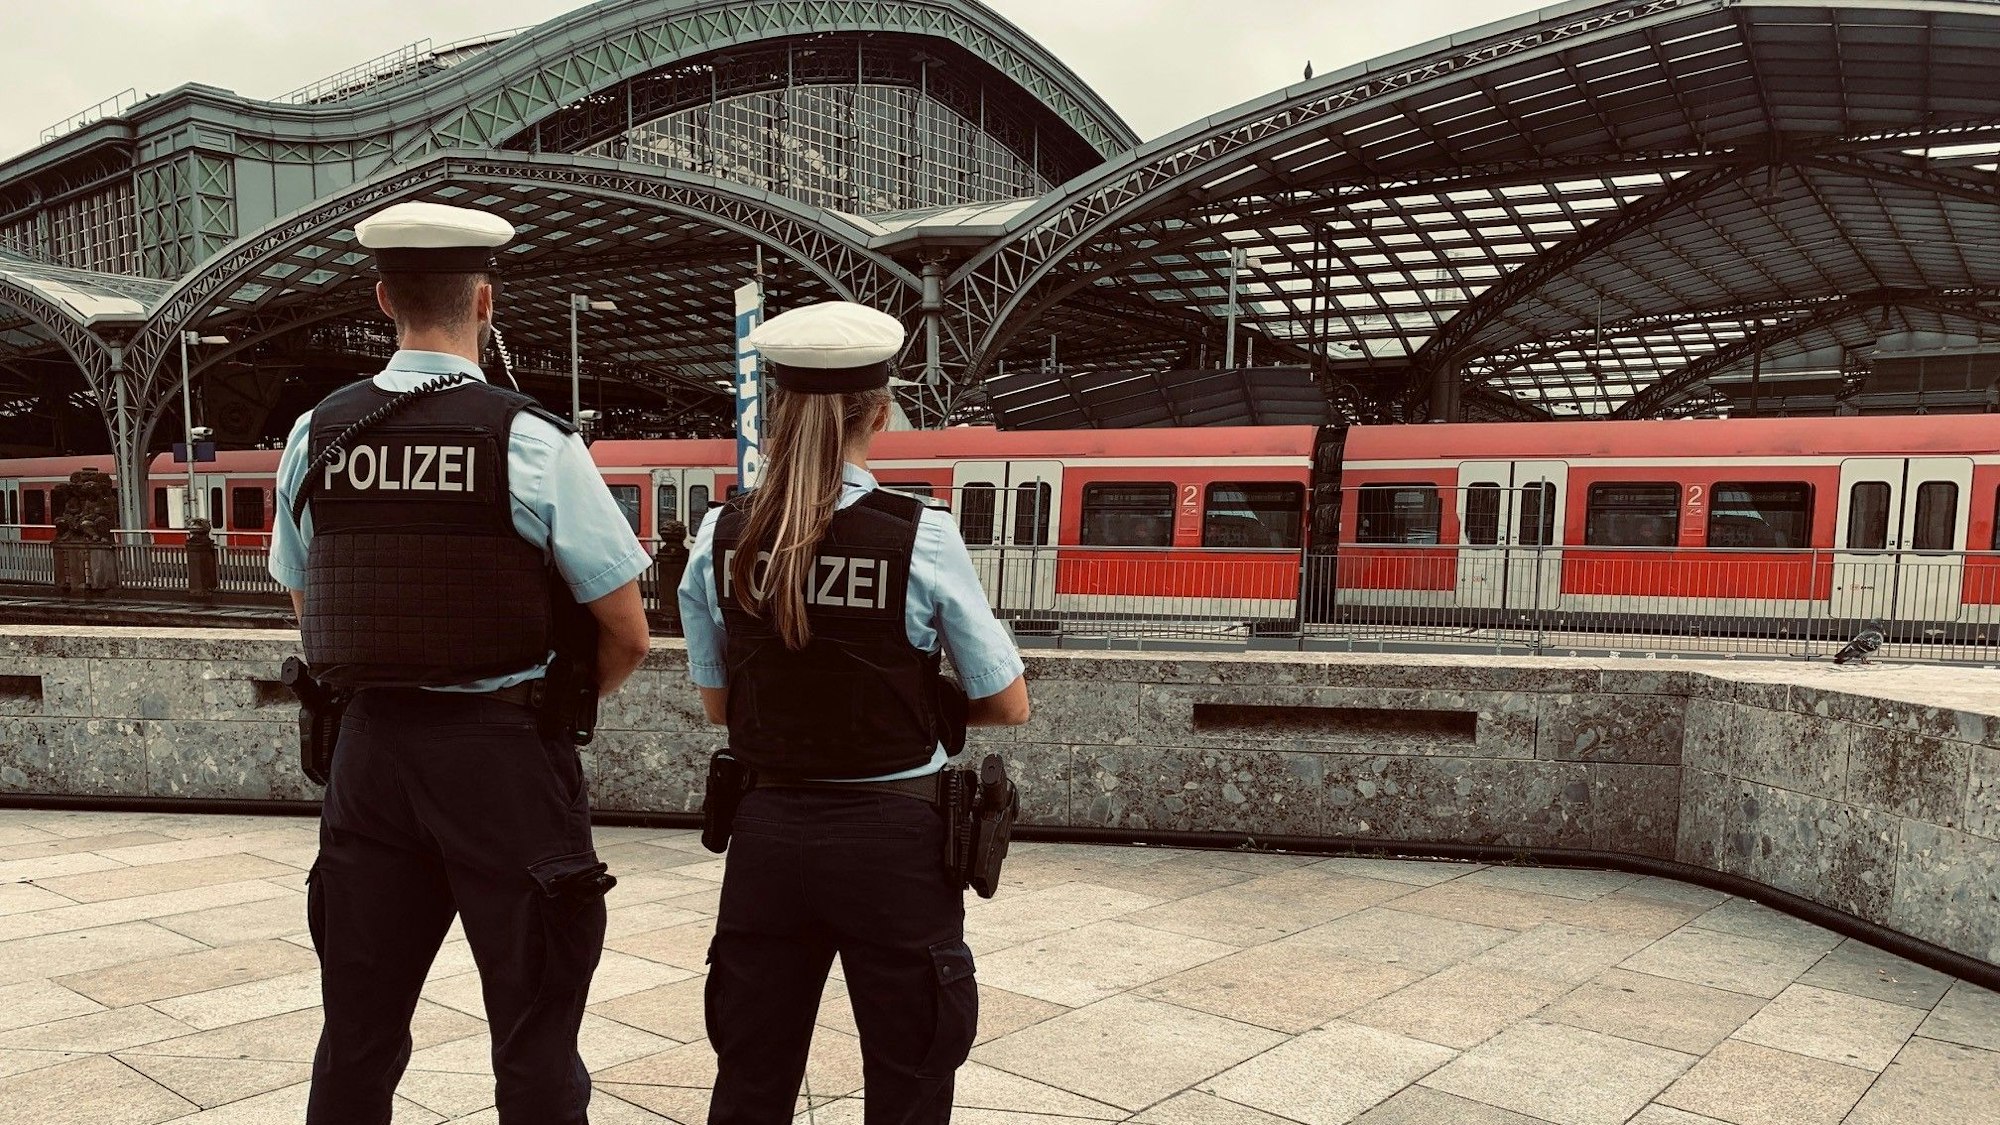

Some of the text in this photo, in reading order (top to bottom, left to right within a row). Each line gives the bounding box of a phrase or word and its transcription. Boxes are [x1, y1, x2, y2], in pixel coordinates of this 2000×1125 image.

[324, 444, 475, 492] POLIZEI
[1183, 485, 1198, 506] 2
[1687, 485, 1703, 506] 2
[723, 549, 888, 609] POIZEI
